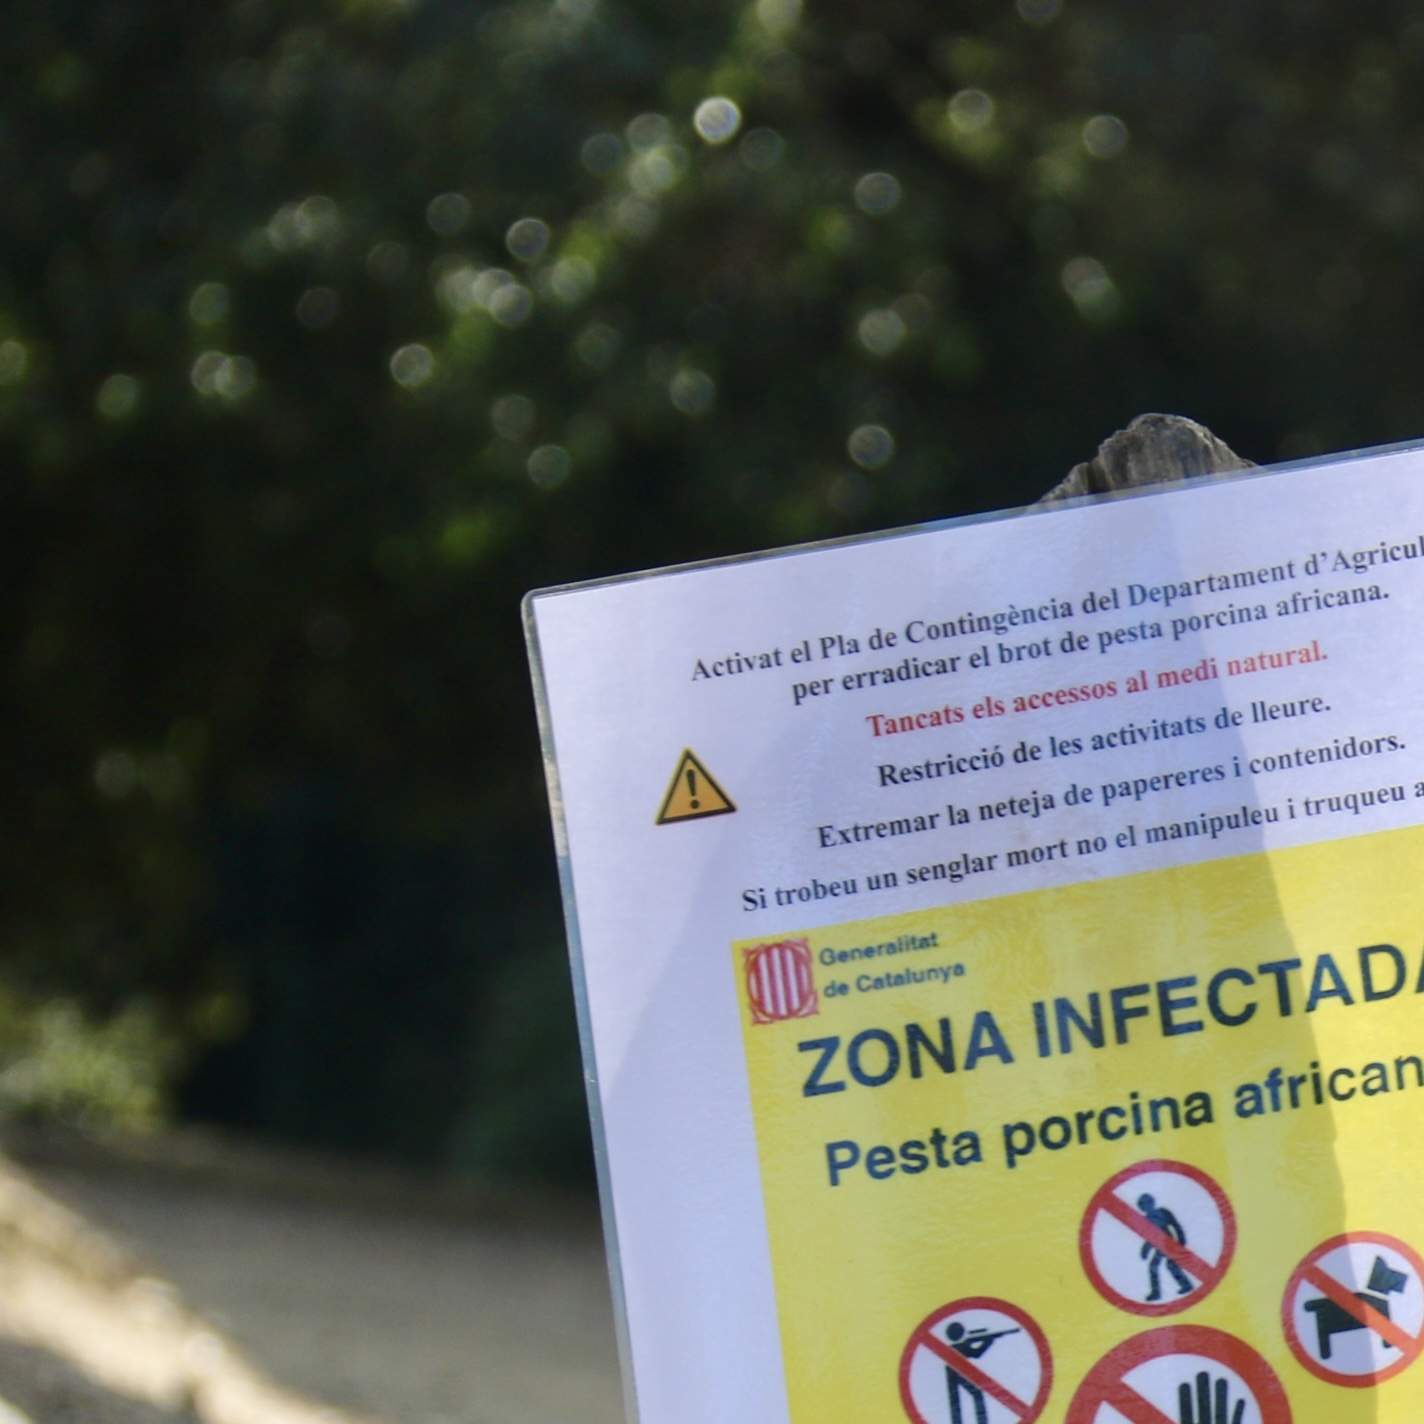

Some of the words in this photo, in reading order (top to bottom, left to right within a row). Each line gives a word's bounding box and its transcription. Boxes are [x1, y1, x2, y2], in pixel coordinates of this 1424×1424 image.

[691, 647, 783, 681] Activat
[790, 640, 812, 664] el
[818, 634, 861, 659] Pla
[868, 627, 897, 651] de
[904, 597, 1074, 644] Contingència
[1081, 587, 1120, 614] del
[1127, 560, 1296, 606] Departament
[791, 678, 834, 707] per
[841, 655, 961, 691] erradicar
[968, 645, 991, 669] el
[997, 637, 1053, 664] brot
[1059, 630, 1090, 654] de
[1096, 621, 1164, 654] pesta
[1170, 603, 1268, 641] porcina
[1275, 584, 1389, 616] africana.
[864, 704, 965, 738] Tancats
[971, 695, 1006, 720] els
[1012, 680, 1118, 713] accessos
[1125, 669, 1149, 694] al
[1156, 657, 1218, 688] medi
[1226, 639, 1328, 676] natural.
[877, 744, 1005, 787] Restricció
[1012, 740, 1042, 764] de
[1049, 735, 1083, 758] les
[1090, 715, 1206, 751] activitats
[1213, 706, 1243, 729] de
[1250, 697, 1331, 723] lleure.
[816, 812, 940, 848] Extremar
[946, 804, 971, 826] la
[978, 789, 1056, 821] neteja
[1063, 783, 1093, 806] de
[1100, 764, 1226, 807] papereres
[1232, 755, 1242, 777] i
[1248, 735, 1406, 774] contenidors.
[741, 887, 768, 912] Si
[774, 878, 858, 906] trobeu
[866, 871, 899, 891] un
[905, 852, 998, 885] senglar
[1005, 839, 1069, 867] mort
[1075, 836, 1107, 855] no
[1115, 824, 1137, 848] el
[1144, 805, 1279, 844] manipuleu
[1287, 797, 1296, 819] i
[1302, 785, 1406, 816] truqueu
[818, 931, 939, 966] Generalitat
[822, 979, 850, 998] de
[854, 962, 966, 993] Catalunya
[797, 1010, 1015, 1098] ZONA
[824, 1127, 984, 1187] Pesta
[1001, 1091, 1215, 1169] porcina
